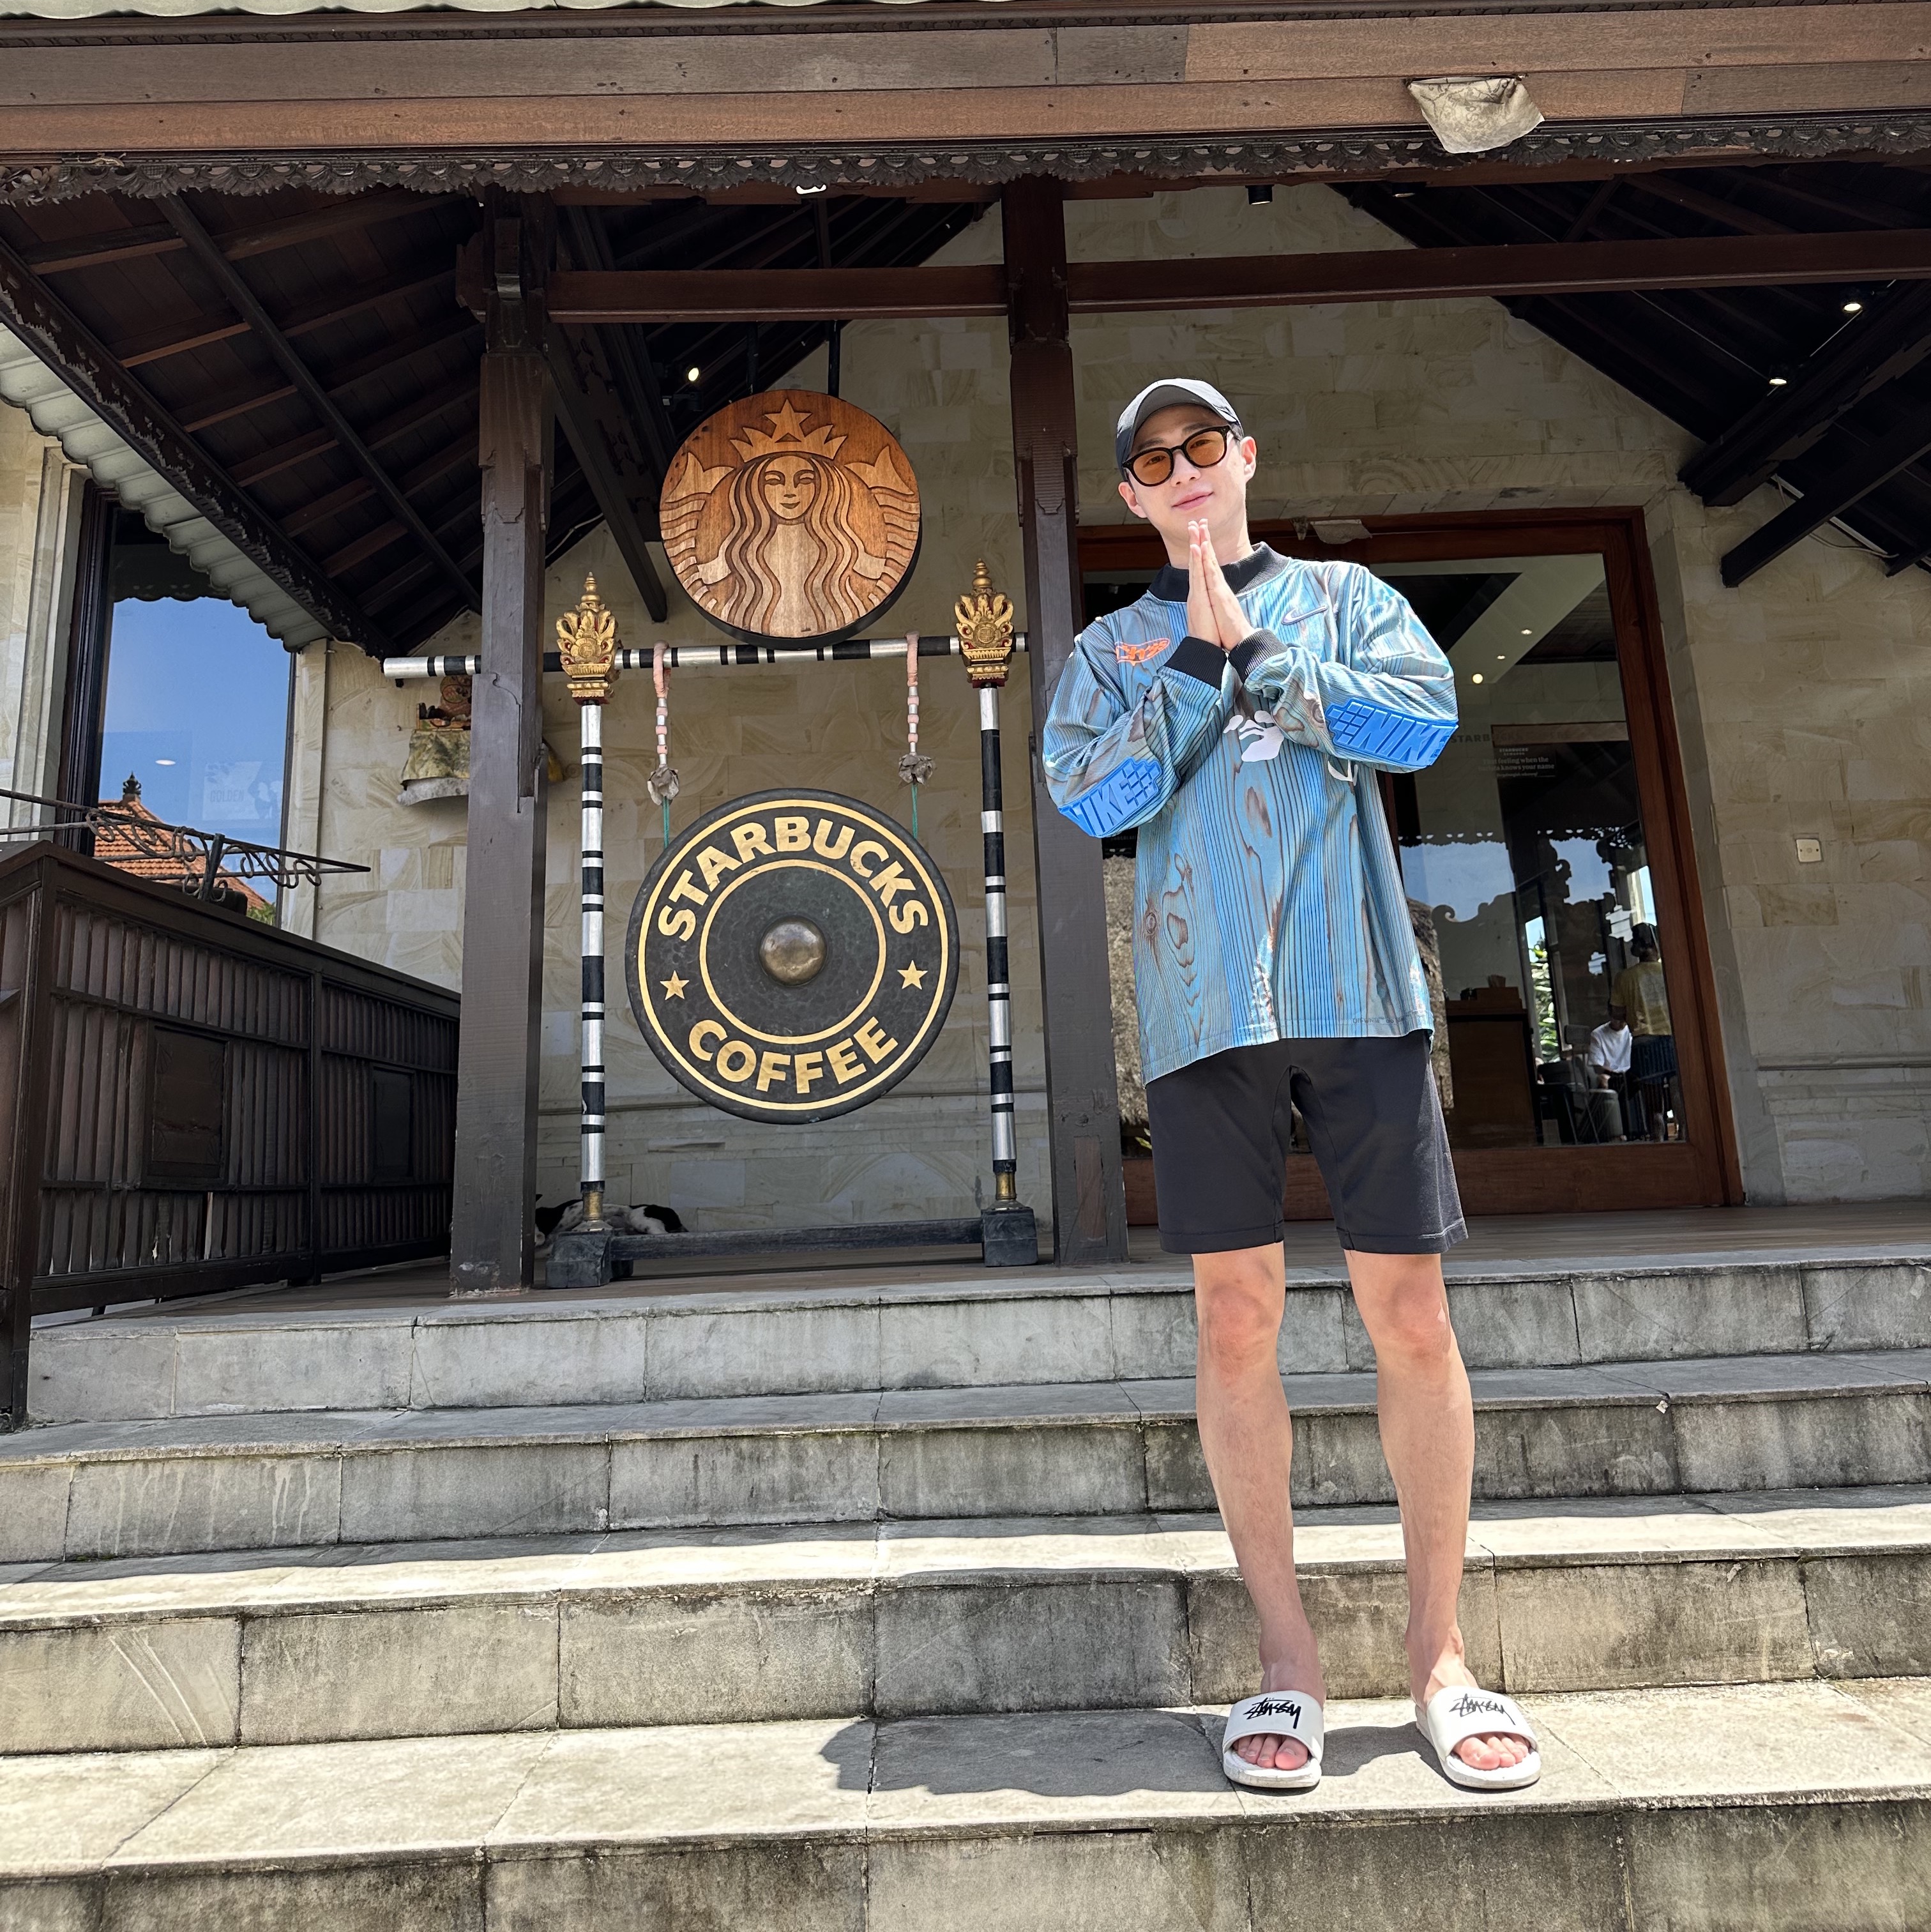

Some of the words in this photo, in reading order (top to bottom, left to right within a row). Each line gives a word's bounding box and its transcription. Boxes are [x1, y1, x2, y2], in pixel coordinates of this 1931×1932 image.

[209, 789, 245, 803] GOLDEN
[658, 816, 929, 942] STARBUCKS
[688, 1016, 898, 1094] COFFEE
